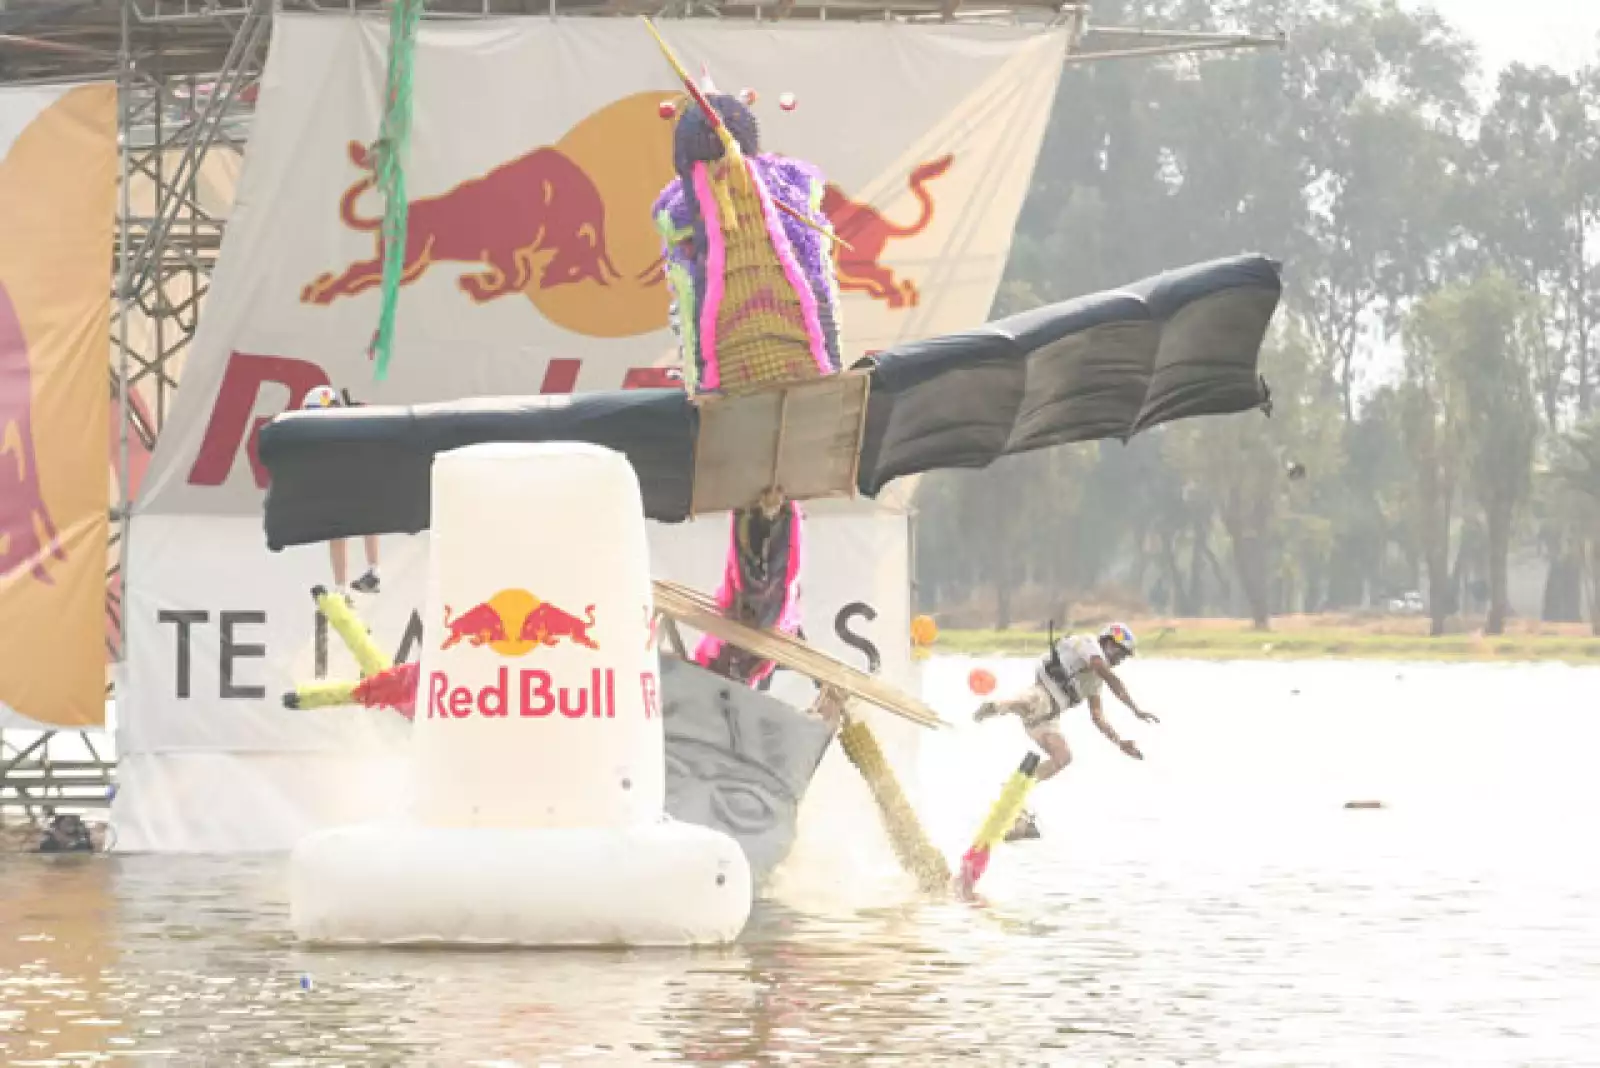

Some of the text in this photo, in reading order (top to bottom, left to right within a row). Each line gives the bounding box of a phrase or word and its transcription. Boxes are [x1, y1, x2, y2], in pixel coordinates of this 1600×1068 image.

[158, 609, 267, 699] TE
[428, 666, 509, 719] Red
[519, 667, 616, 719] Bull
